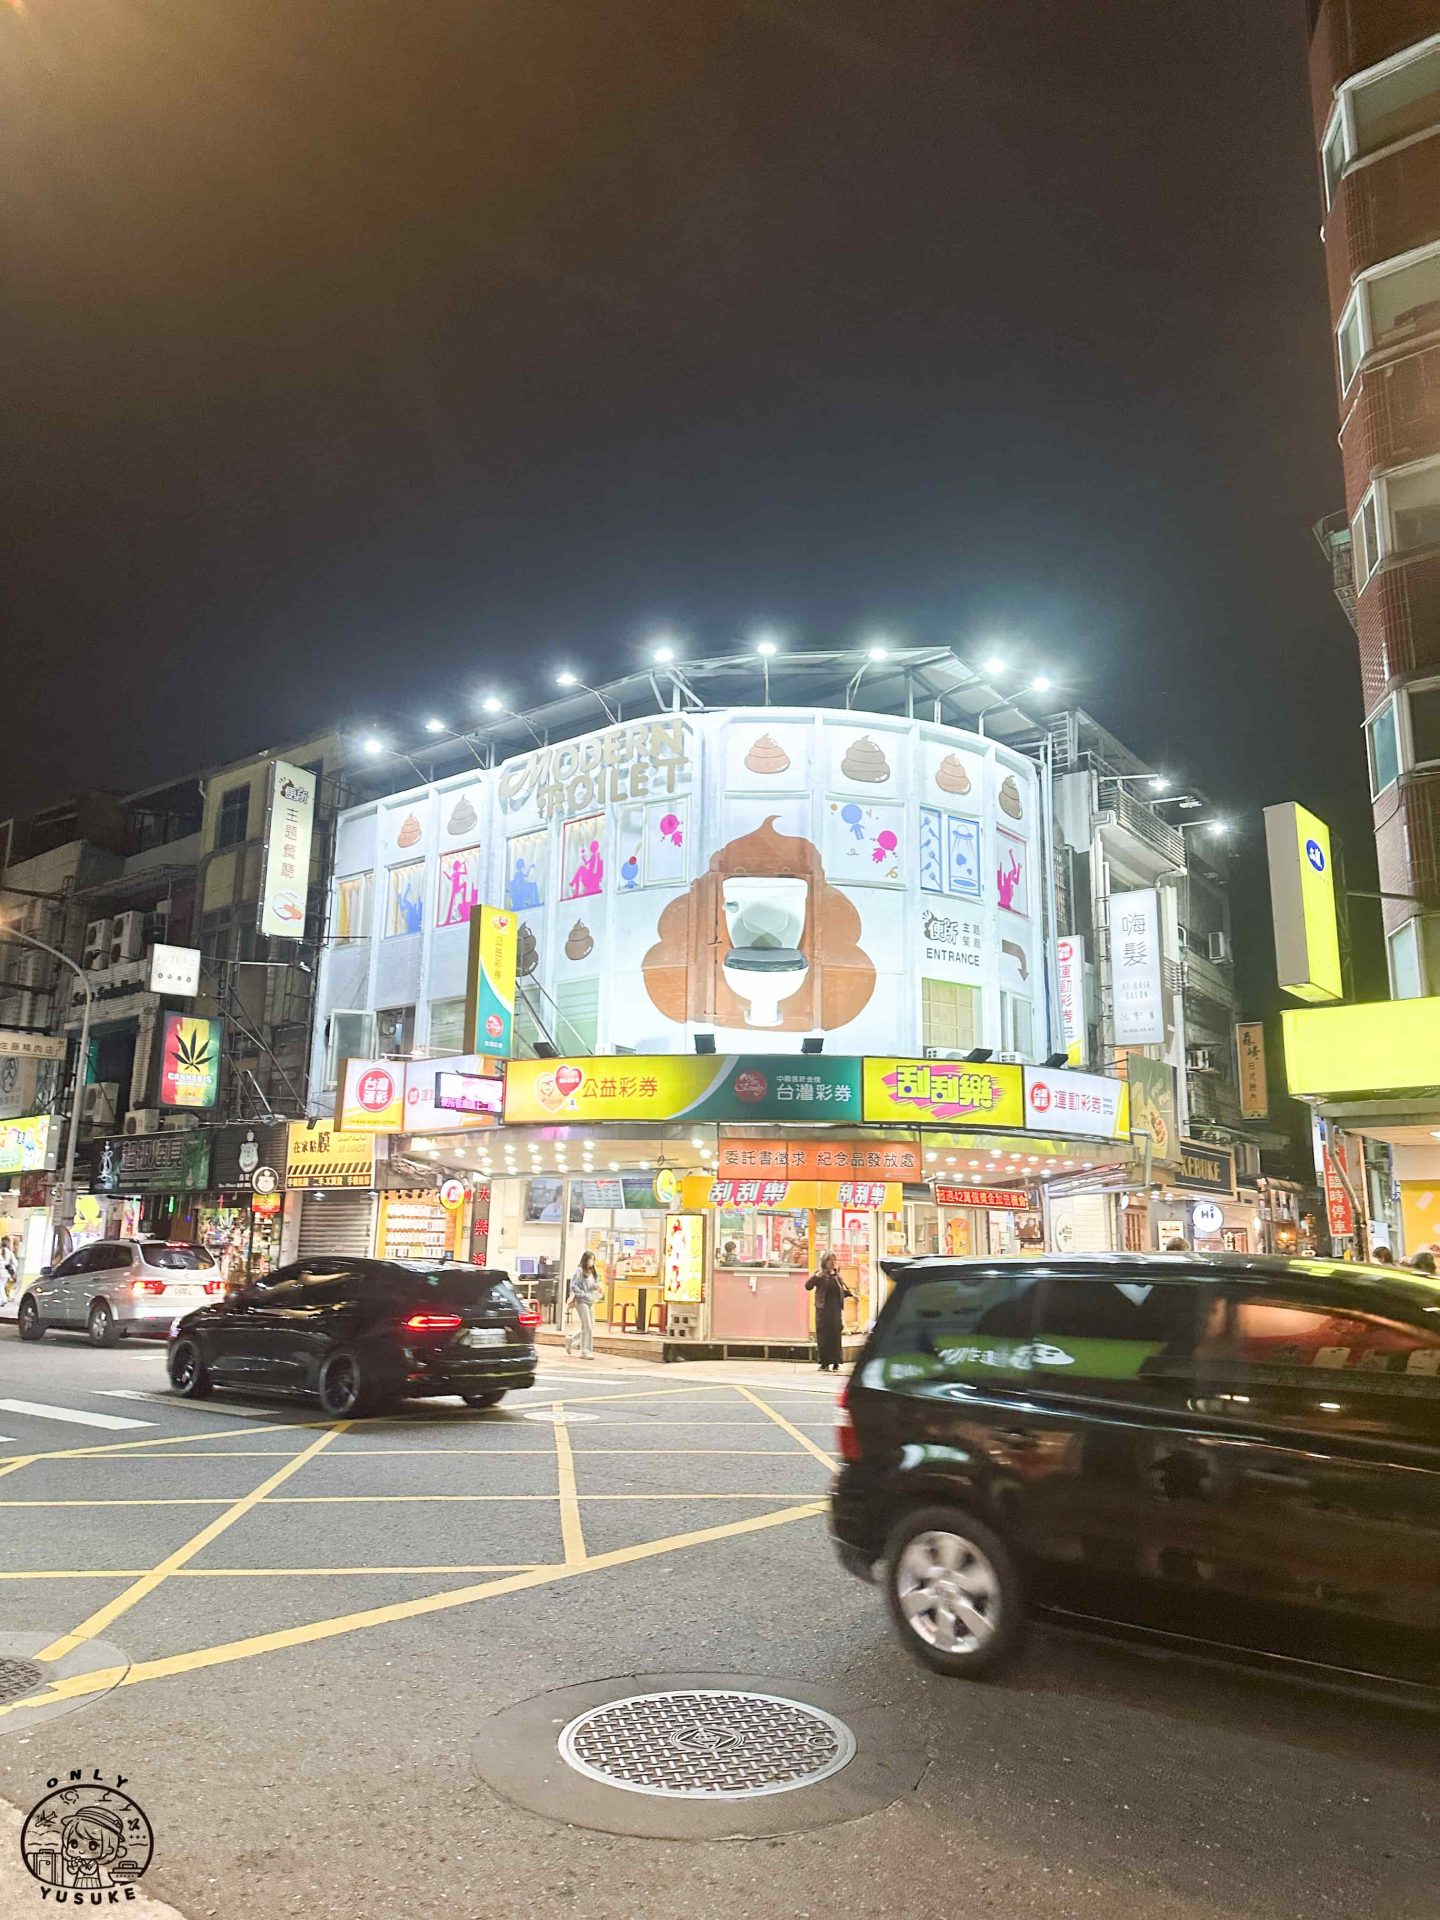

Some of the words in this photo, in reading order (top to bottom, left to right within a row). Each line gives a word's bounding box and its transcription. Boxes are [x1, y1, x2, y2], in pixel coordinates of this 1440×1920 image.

[498, 718, 683, 798] MODERN
[537, 757, 689, 818] TOILET
[281, 808, 299, 878] 主題餐廳
[1122, 912, 1147, 966] 嗨髮
[926, 948, 980, 966] ENTRANCE
[1059, 964, 1073, 1023] 運動彩券
[582, 1076, 658, 1098] 公益彩券
[776, 1083, 852, 1102] 台灣彩券
[897, 1065, 993, 1109] 刮刮樂
[1054, 1090, 1101, 1114] 運動彩券
[725, 1150, 806, 1166] 委託書徵求
[817, 1151, 914, 1168] 紀念品發放處
[709, 1181, 788, 1203] 刮刮樂
[838, 1183, 885, 1205] 刮刮樂
[1323, 1147, 1346, 1234] 止臨時停車
[1201, 1206, 1215, 1220] Hi
